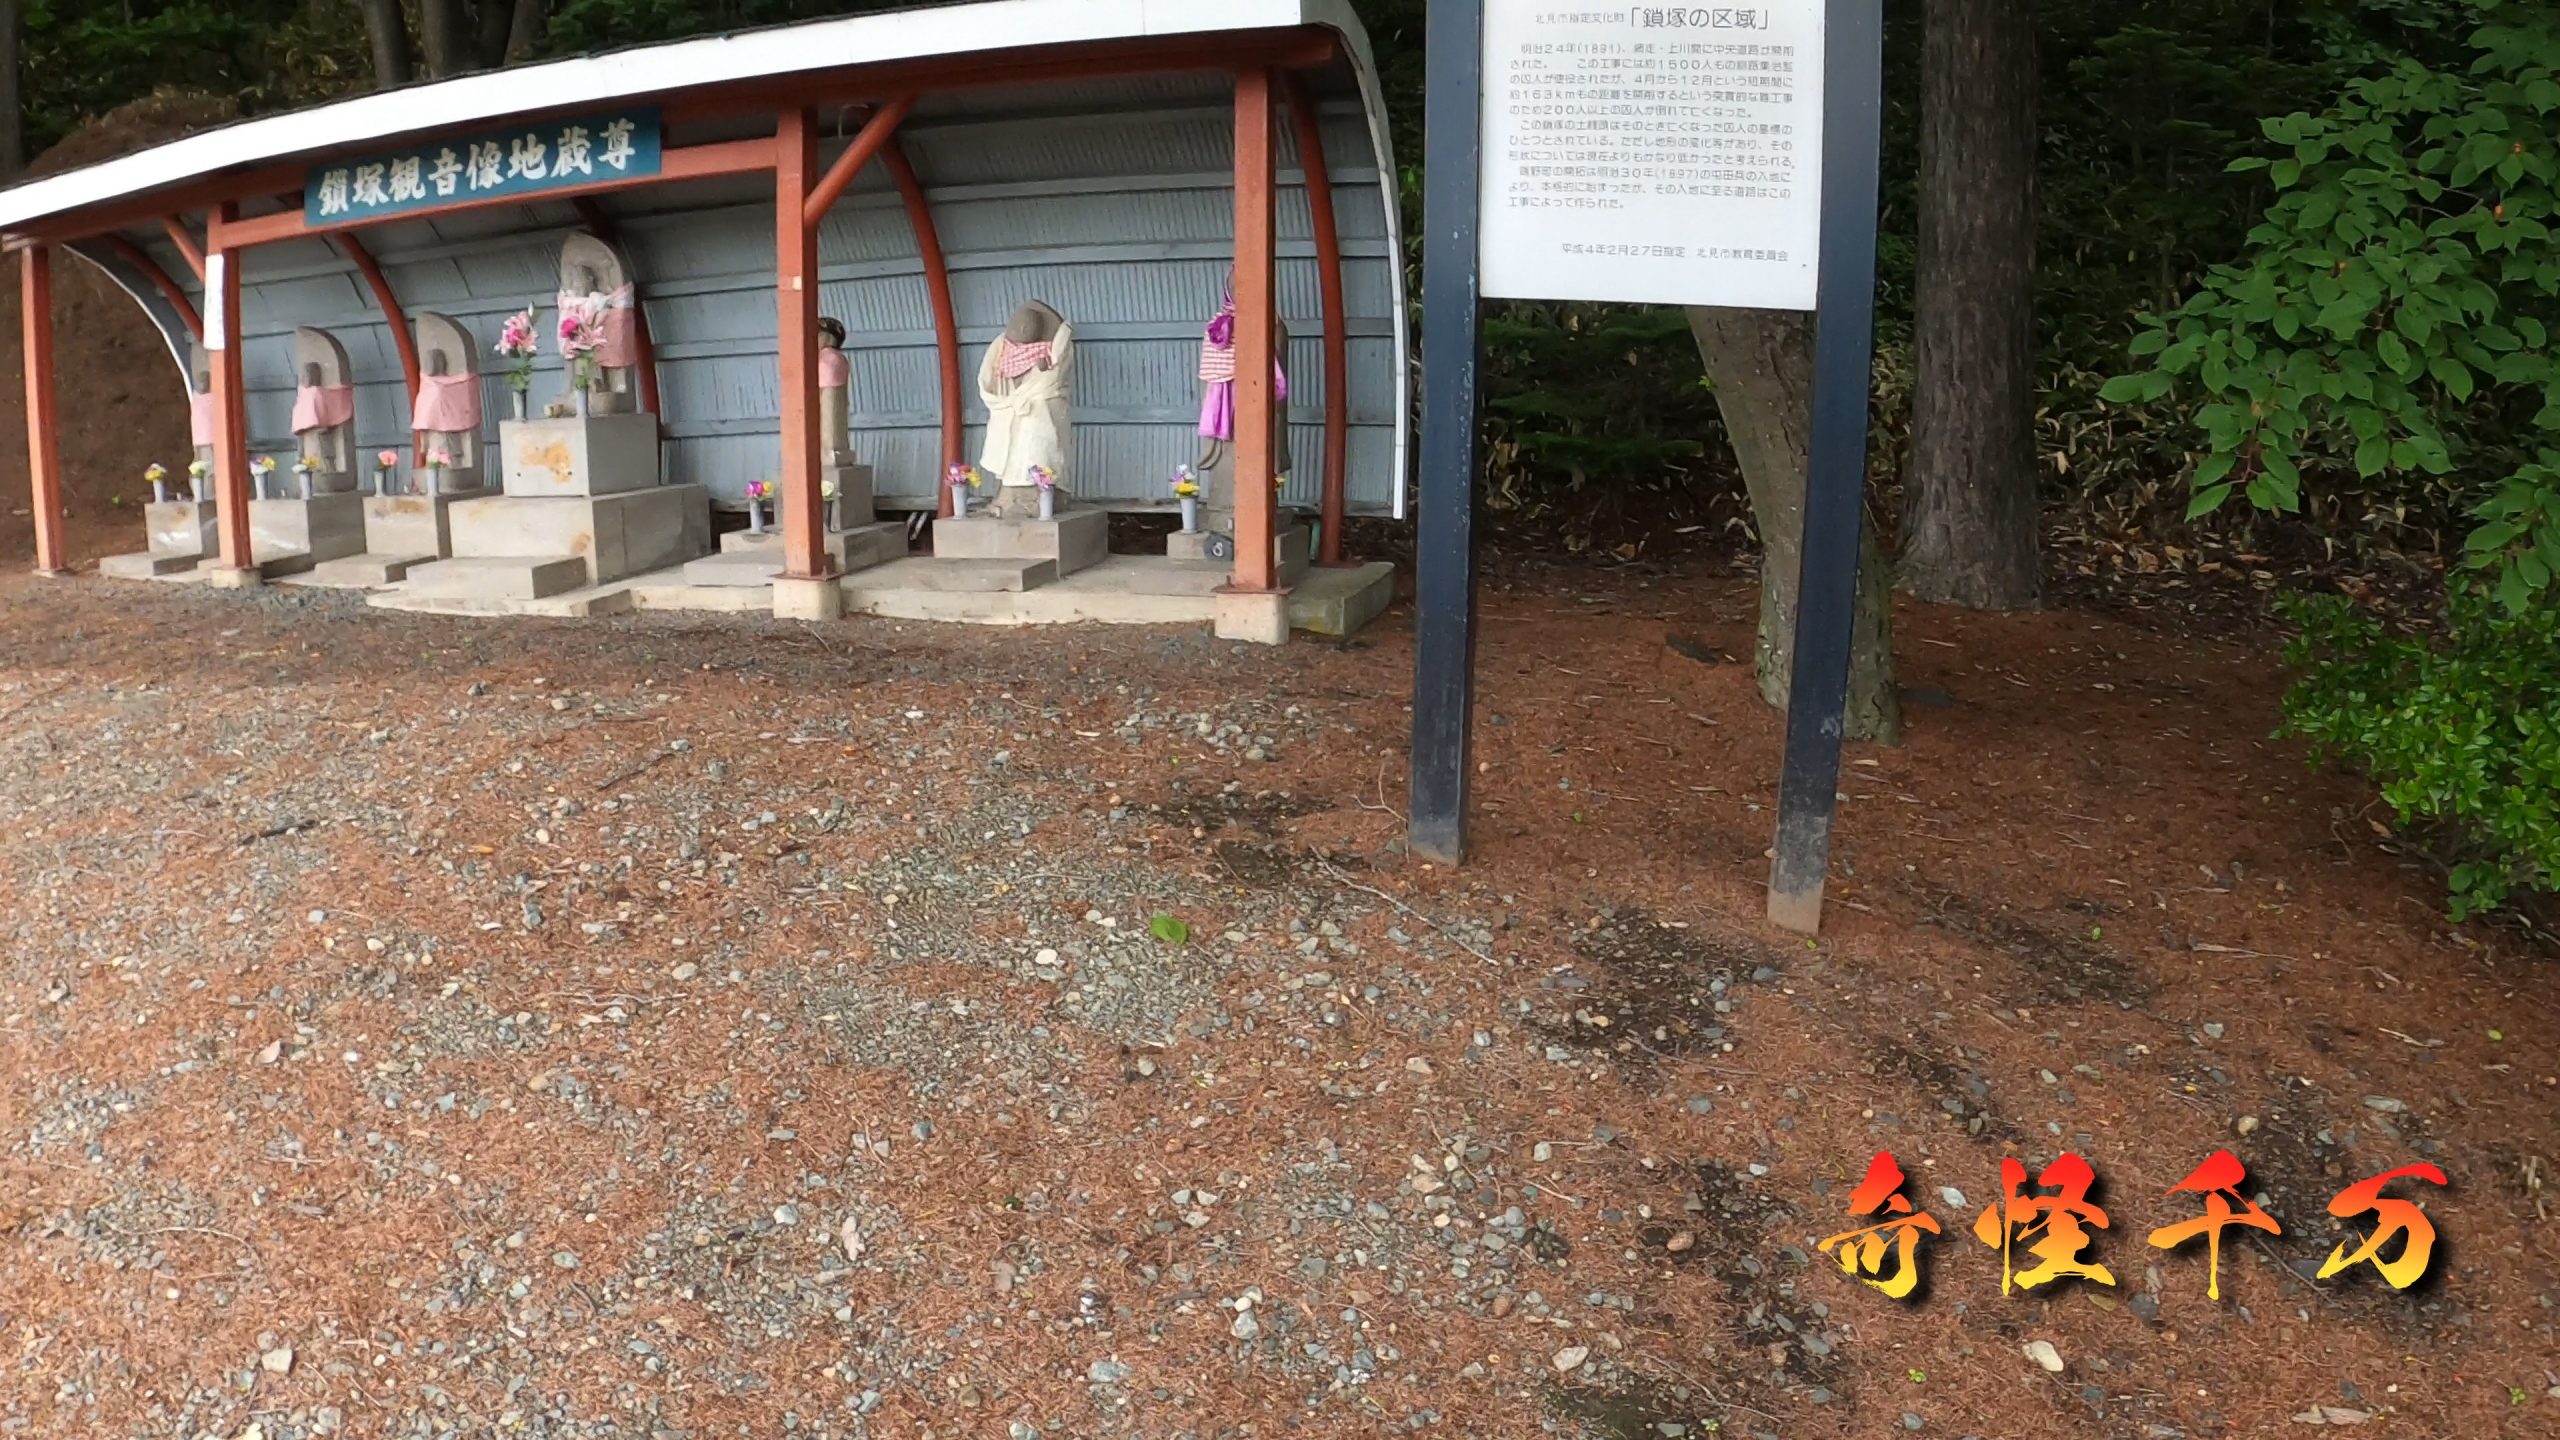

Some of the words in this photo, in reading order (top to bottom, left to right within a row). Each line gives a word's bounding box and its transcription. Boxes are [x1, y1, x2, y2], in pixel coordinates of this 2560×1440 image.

[1631, 7, 1768, 30] 「鎖塚の区域」
